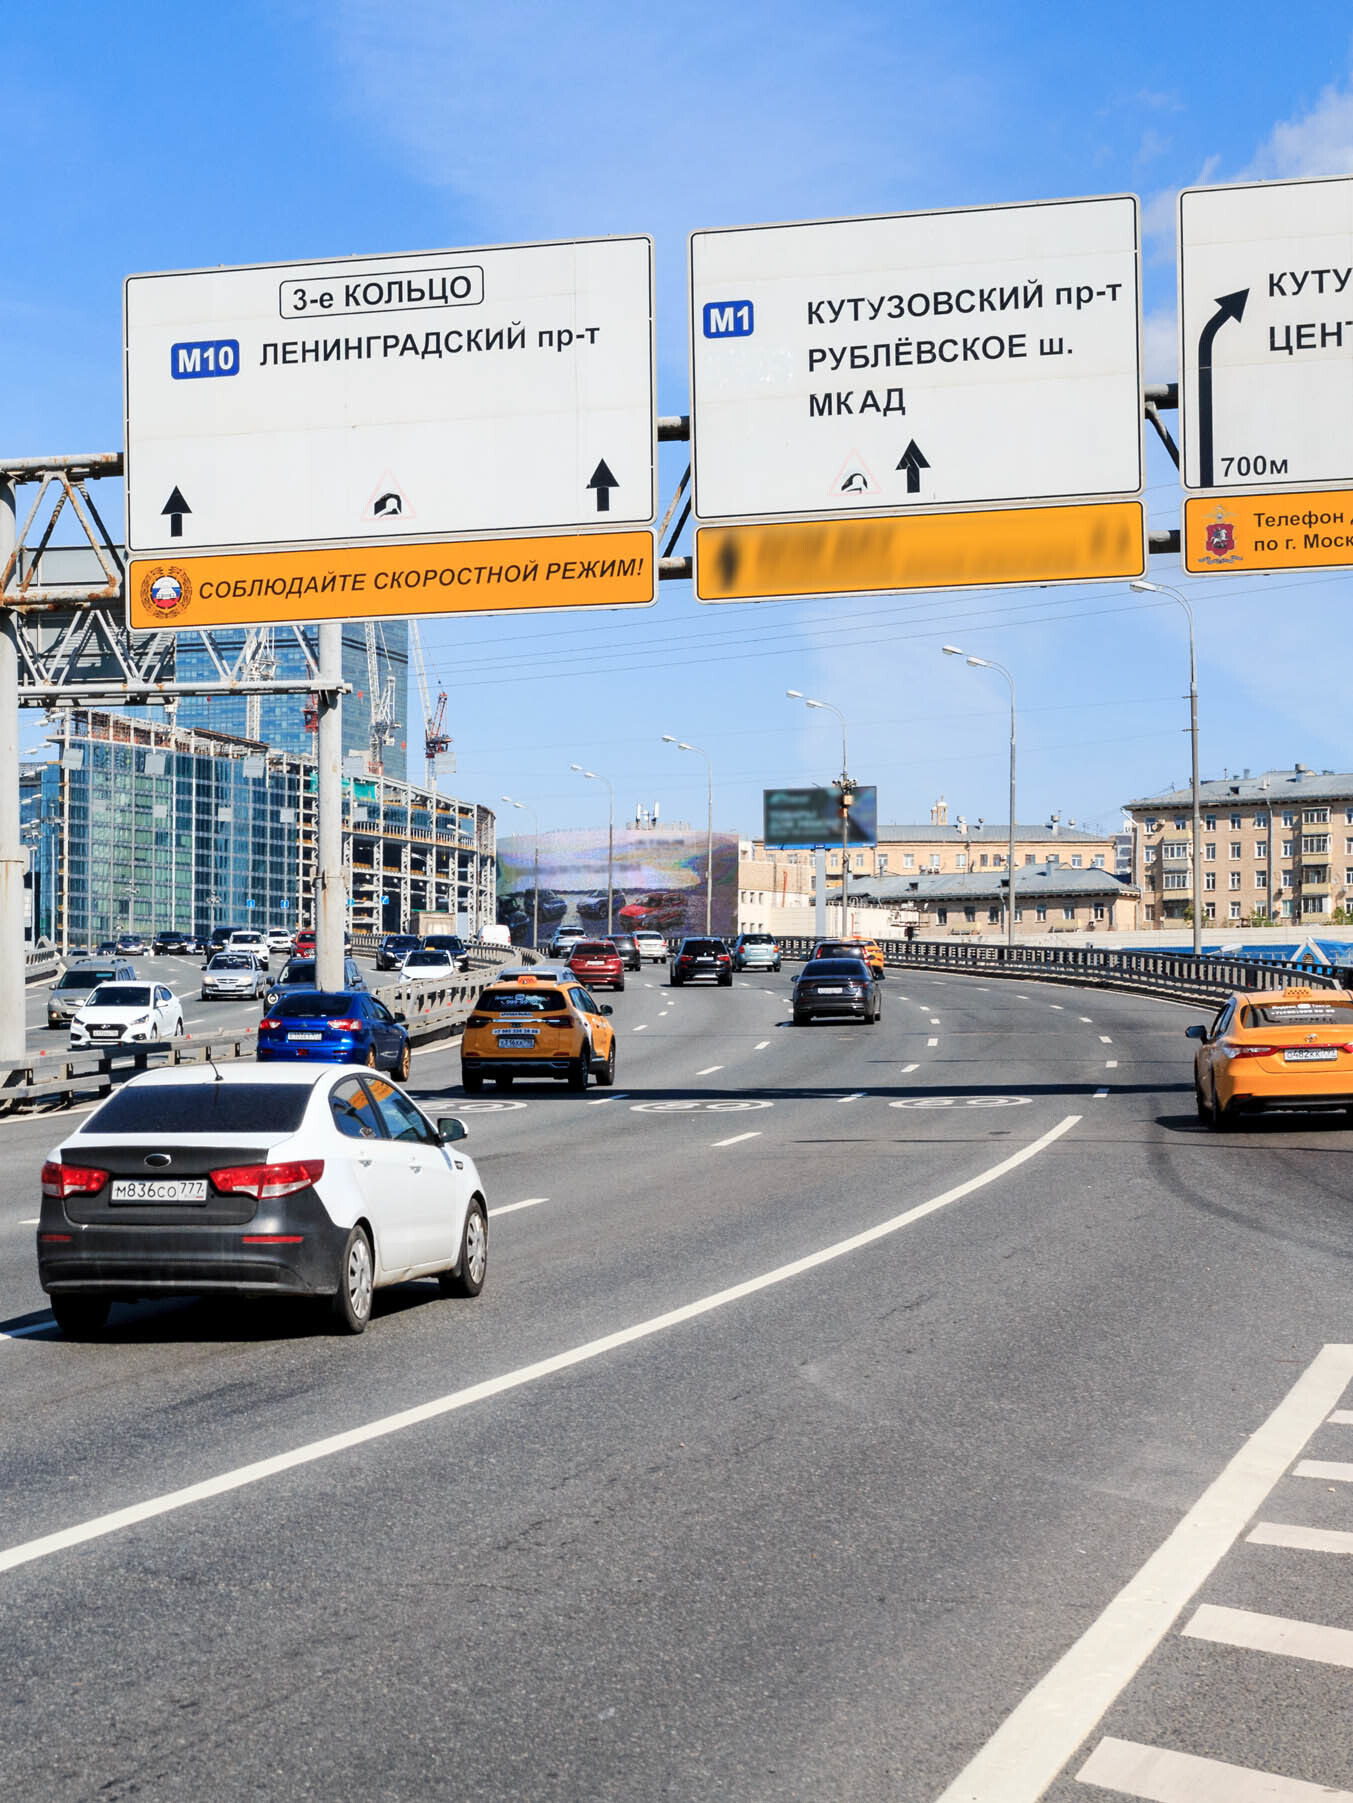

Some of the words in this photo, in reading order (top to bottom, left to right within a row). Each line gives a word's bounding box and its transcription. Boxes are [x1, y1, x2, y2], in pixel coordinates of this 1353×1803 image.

[293, 288, 334, 311] 3-е
[345, 275, 472, 307] КОЛЬЦО
[1269, 267, 1353, 297] КУТУ
[807, 279, 1043, 325] КУТУЗОВСКИЙ
[1055, 283, 1122, 310] пр-т
[709, 305, 749, 334] М1
[259, 320, 525, 366] ЛЕНИНГРАДСКИЙ
[538, 327, 600, 353] пр-т
[808, 334, 1027, 372] РУБЛЁВСКОЕ
[1039, 337, 1074, 356] ш.
[809, 387, 906, 417] МКАД
[1221, 455, 1288, 477] 700м
[1253, 510, 1344, 529] Телефон
[1254, 539, 1279, 552] по
[1285, 538, 1297, 550] г.
[199, 572, 367, 600] СОБЛЮДАЙТЕ
[374, 560, 539, 590] СКОРОСТНОЙ
[545, 558, 644, 581] РЕЖИМ!
